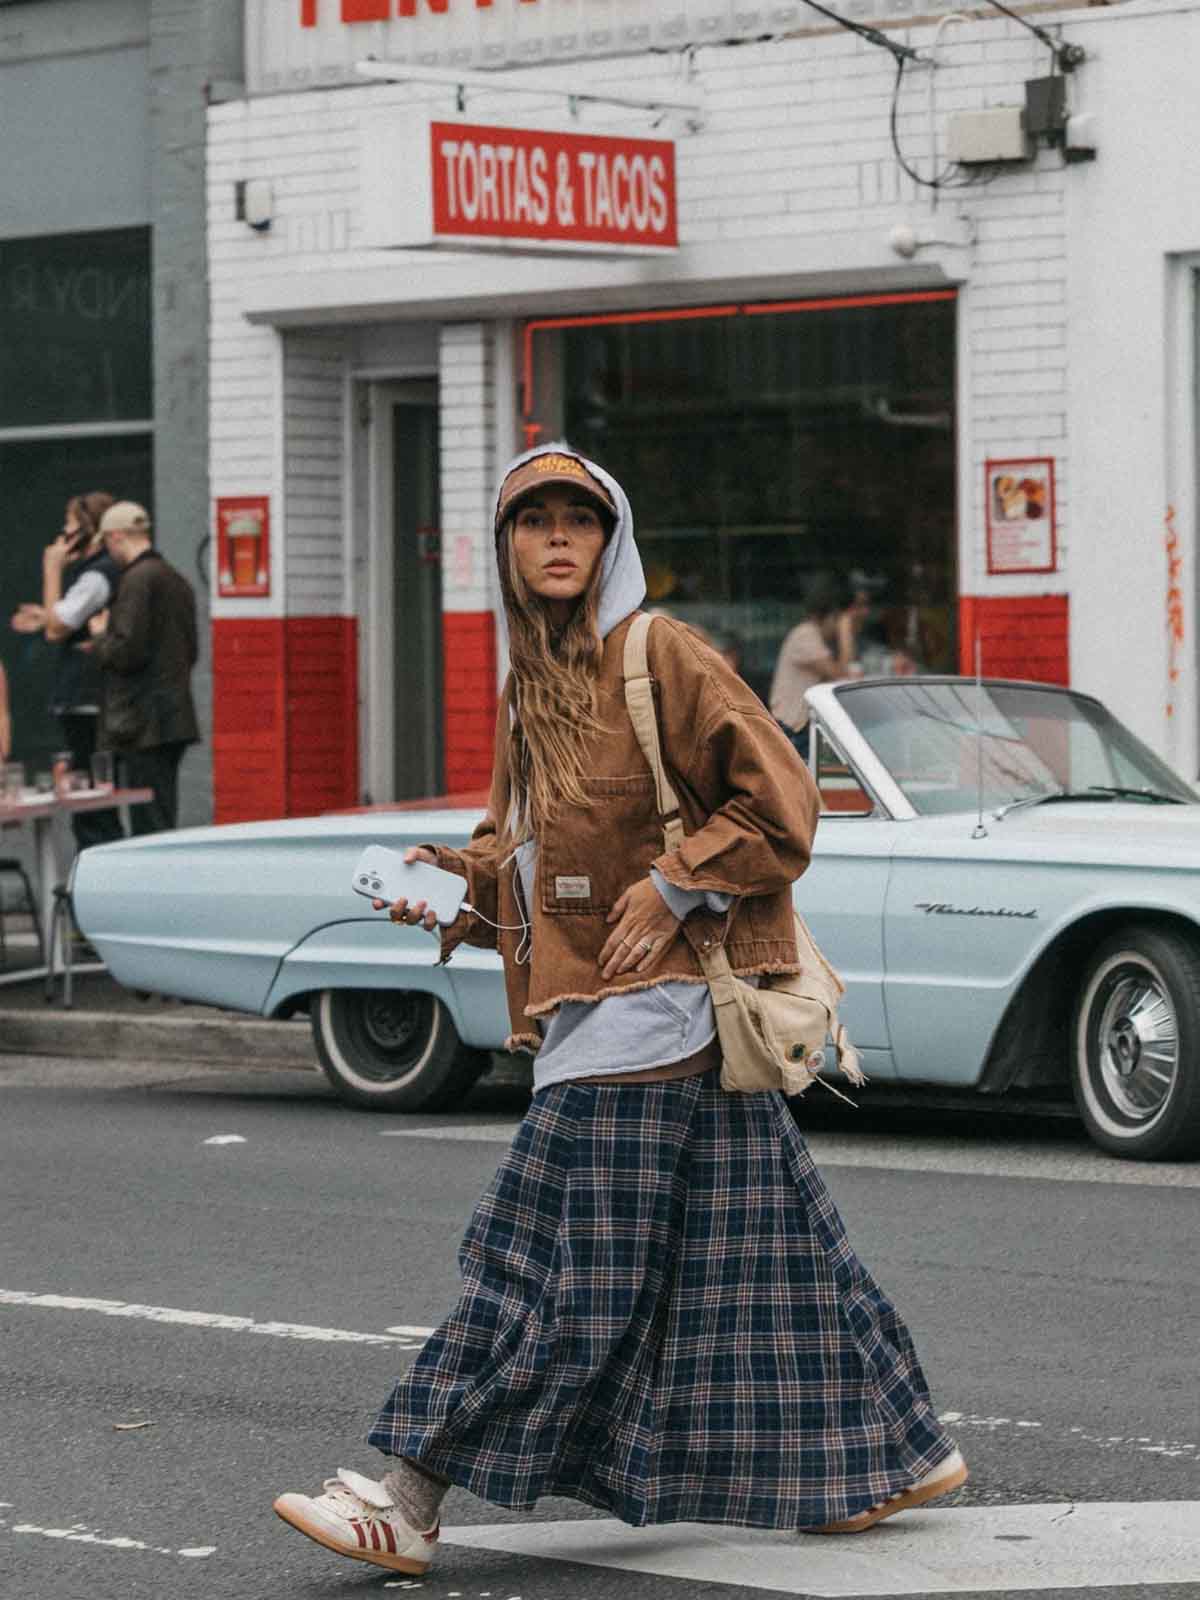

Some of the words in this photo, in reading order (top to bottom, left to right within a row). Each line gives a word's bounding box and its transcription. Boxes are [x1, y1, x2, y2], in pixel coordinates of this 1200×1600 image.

[441, 140, 549, 225] TORTAS
[556, 151, 576, 226] &
[578, 152, 668, 232] TACOS
